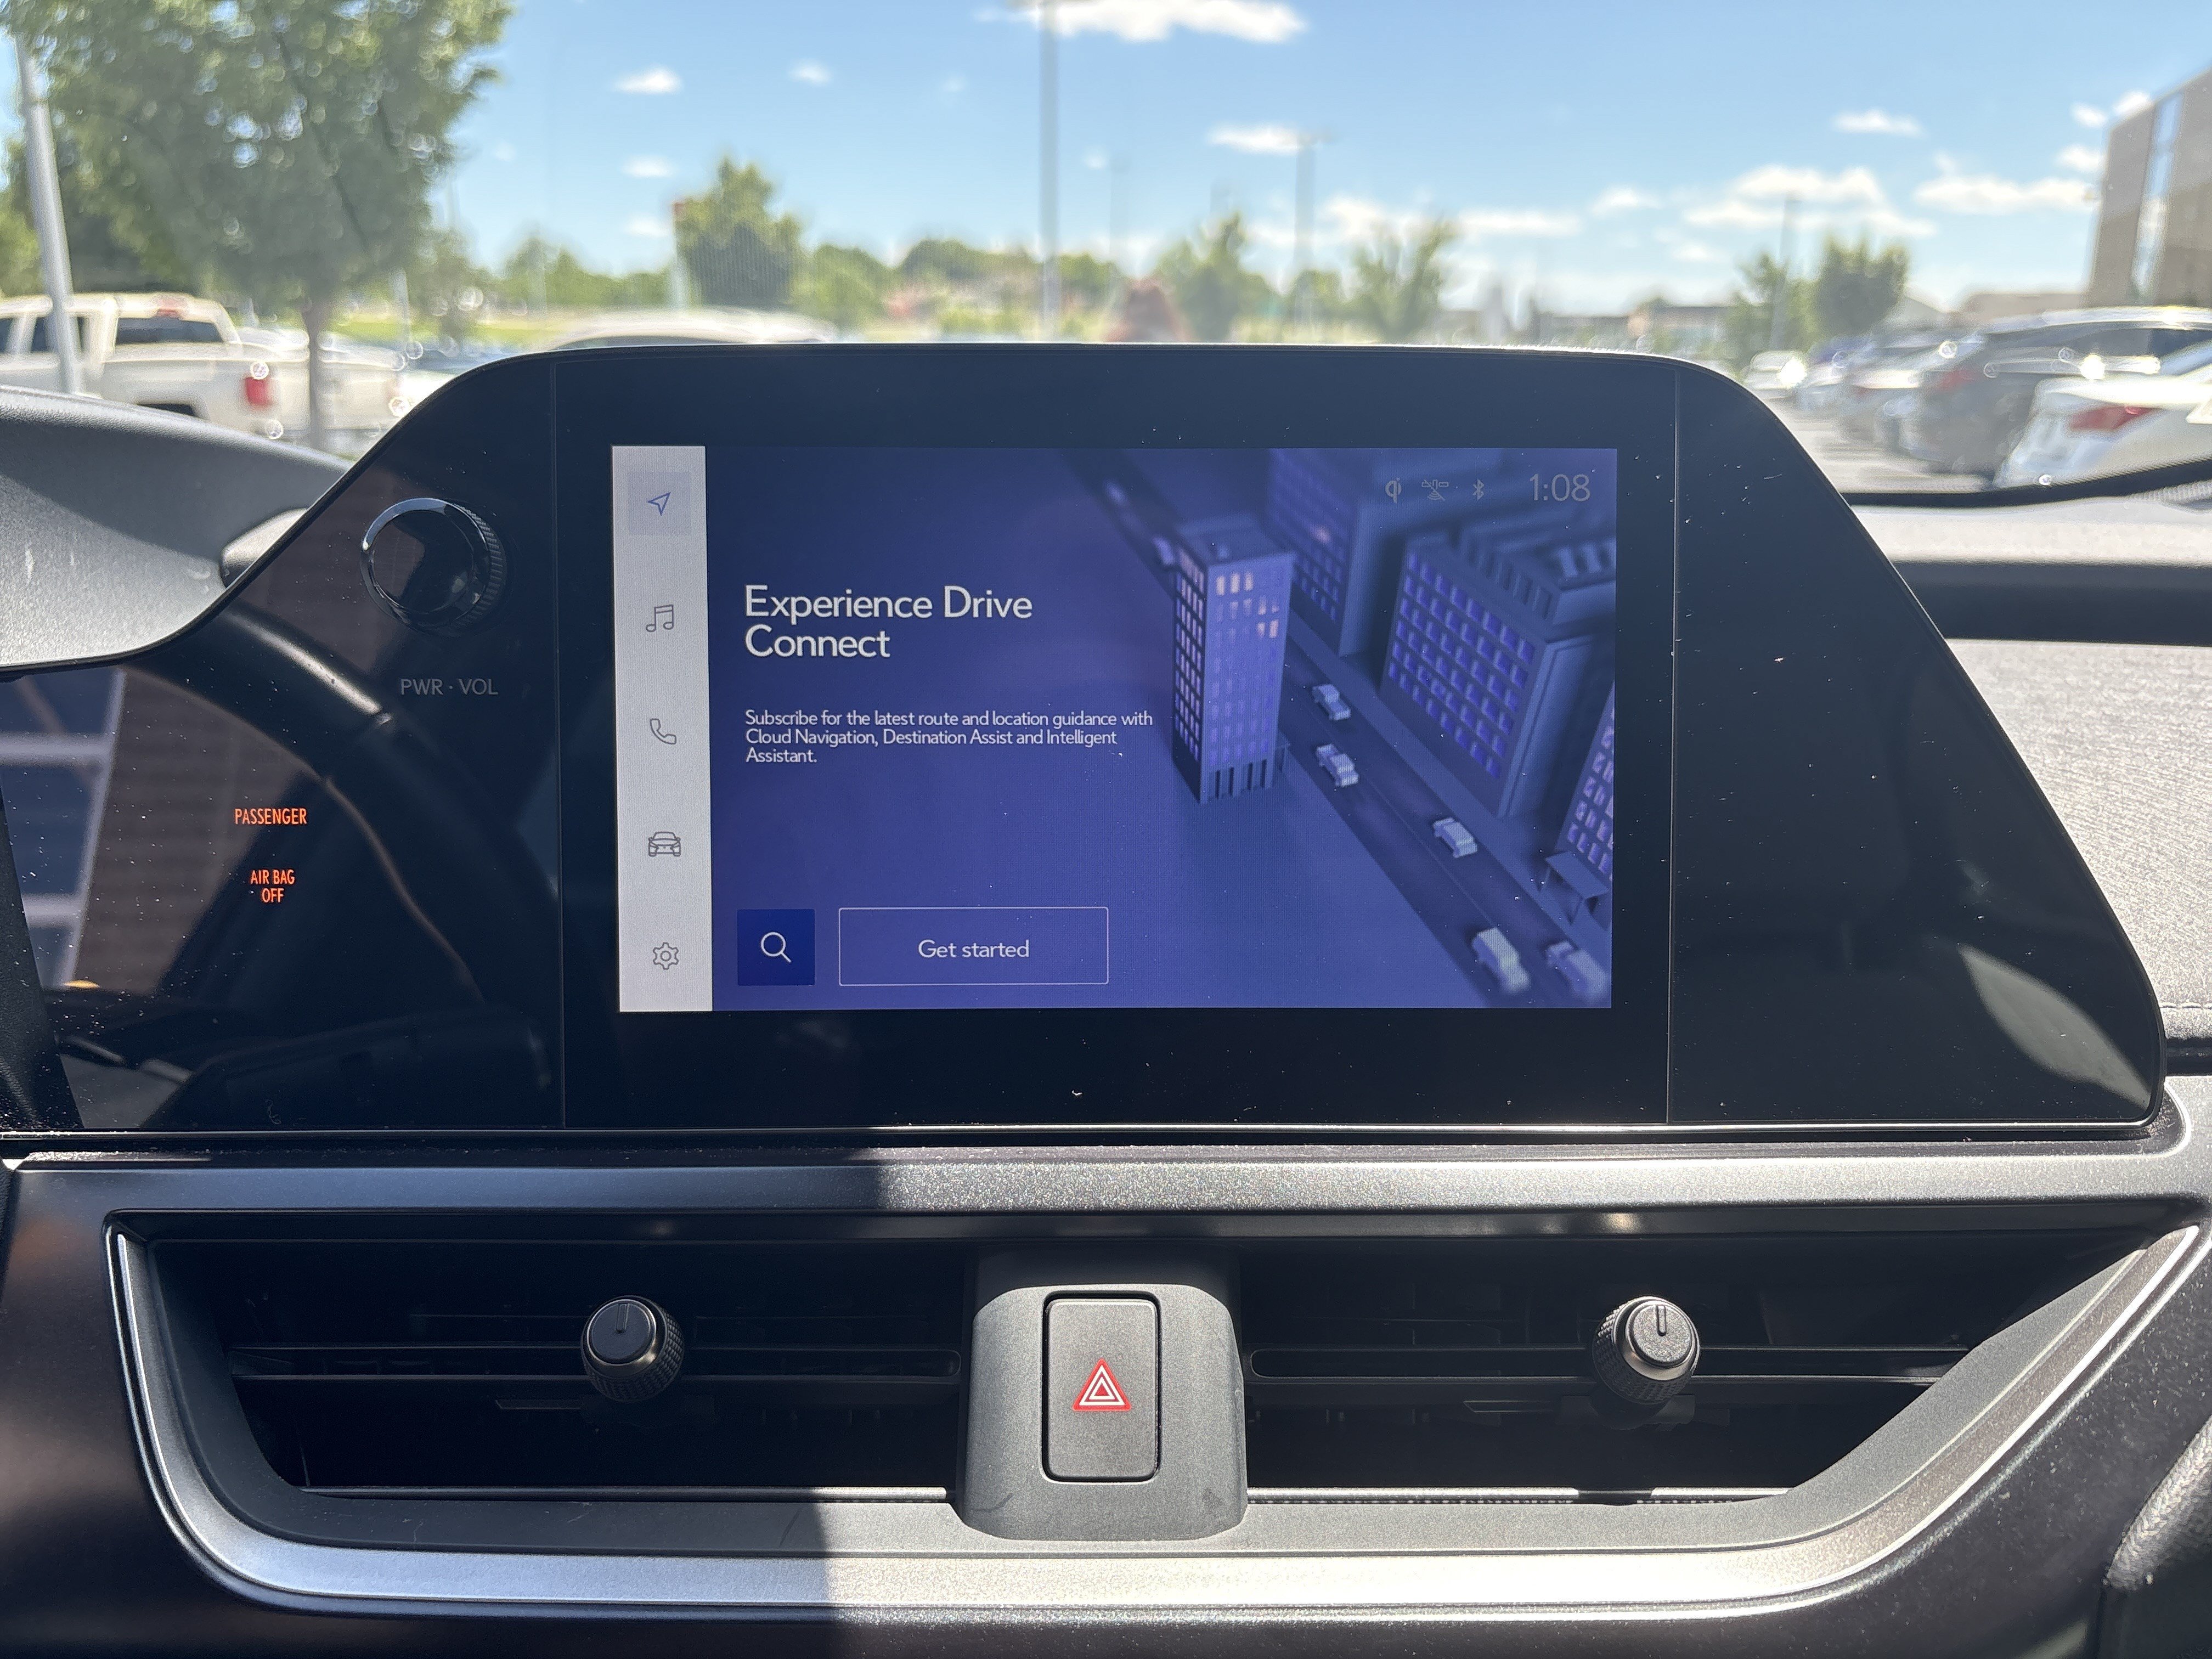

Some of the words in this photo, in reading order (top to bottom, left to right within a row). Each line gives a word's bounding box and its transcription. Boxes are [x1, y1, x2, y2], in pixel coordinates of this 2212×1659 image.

[1529, 473, 1590, 502] 1:08
[746, 585, 933, 624] Experience
[944, 585, 1032, 618] Drive
[746, 624, 890, 658] Connect
[400, 679, 443, 695] PWR
[460, 679, 499, 695] VOL
[746, 710, 818, 725] Subscribe
[821, 710, 842, 725] for
[847, 710, 871, 725] the
[875, 710, 915, 725] latest
[918, 712, 958, 726] route
[962, 710, 989, 726] and
[992, 710, 1049, 726] location
[1052, 710, 1117, 729] guidance
[1121, 710, 1153, 726] with
[746, 729, 792, 744] Cloud
[795, 729, 879, 748] Navigation,
[883, 729, 967, 744] Destination
[969, 729, 1013, 744] Assist
[1016, 729, 1043, 744] and
[1047, 729, 1118, 748] Intelligent
[746, 747, 817, 763] Assistant.
[235, 808, 307, 825] PASSENGER
[250, 870, 269, 885] AIR
[273, 870, 295, 885] BAG
[262, 888, 284, 904] OFF
[918, 939, 957, 958] Get
[962, 939, 1029, 958] started
